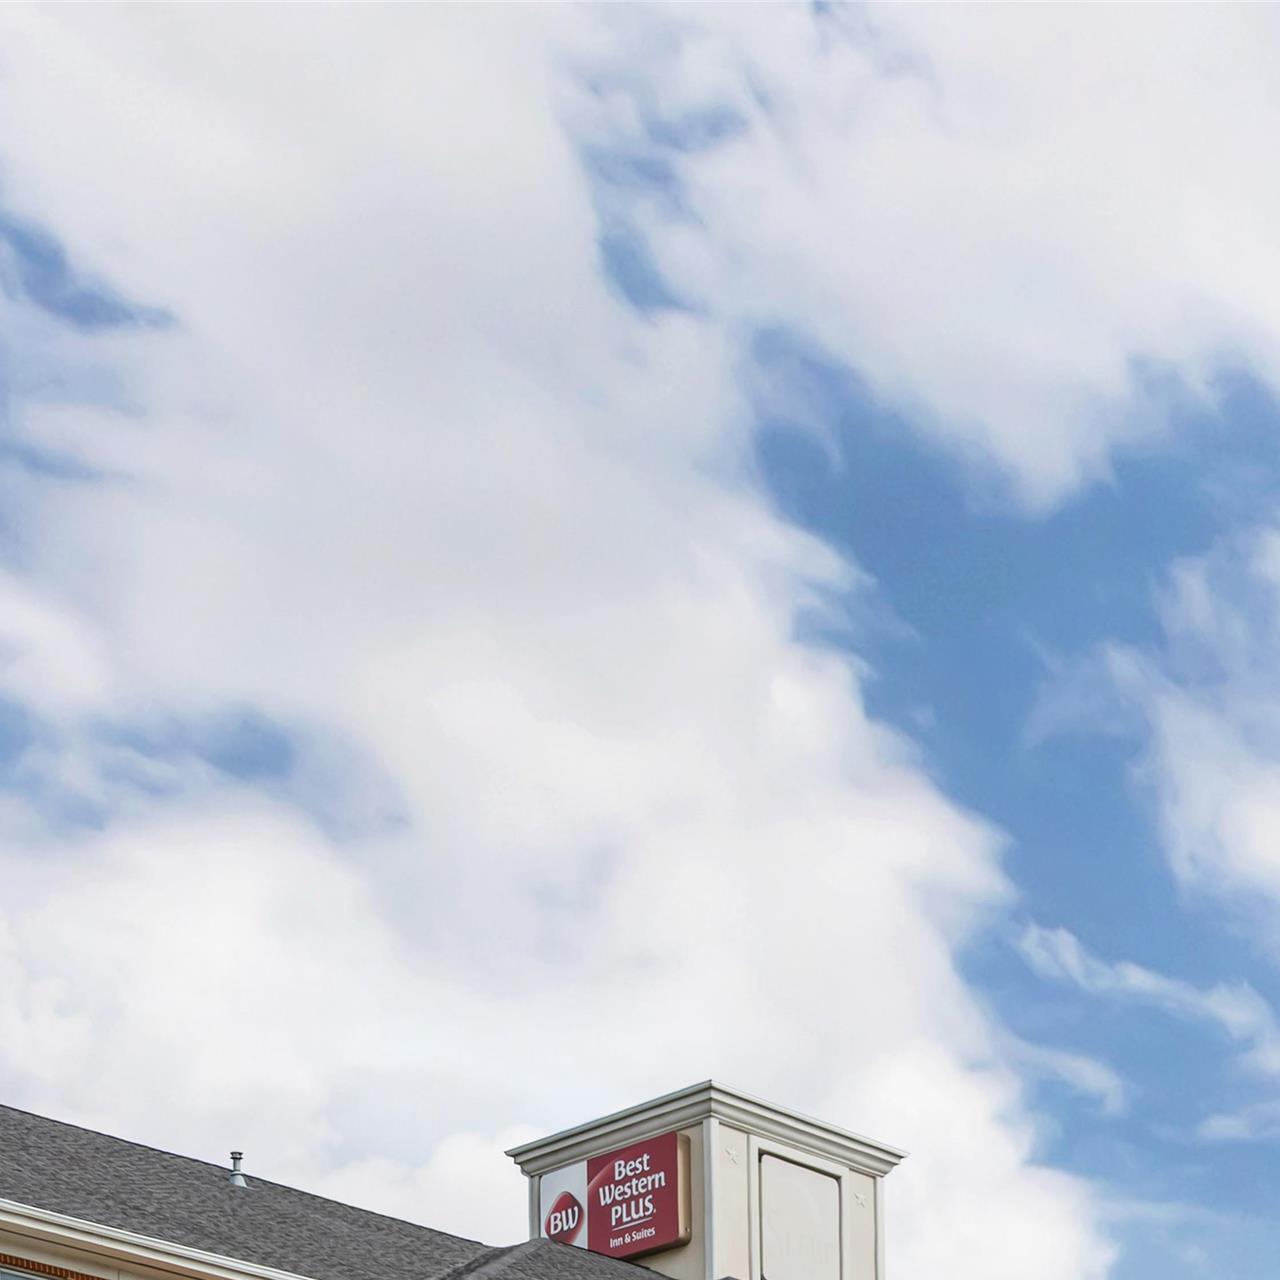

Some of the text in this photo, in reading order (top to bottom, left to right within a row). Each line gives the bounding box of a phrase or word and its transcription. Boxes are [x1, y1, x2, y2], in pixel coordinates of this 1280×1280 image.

[614, 1153, 650, 1181] Best
[598, 1171, 666, 1207] Western
[549, 1206, 579, 1235] BW
[611, 1195, 654, 1226] PLUS
[609, 1226, 656, 1248] Inn & Suites
